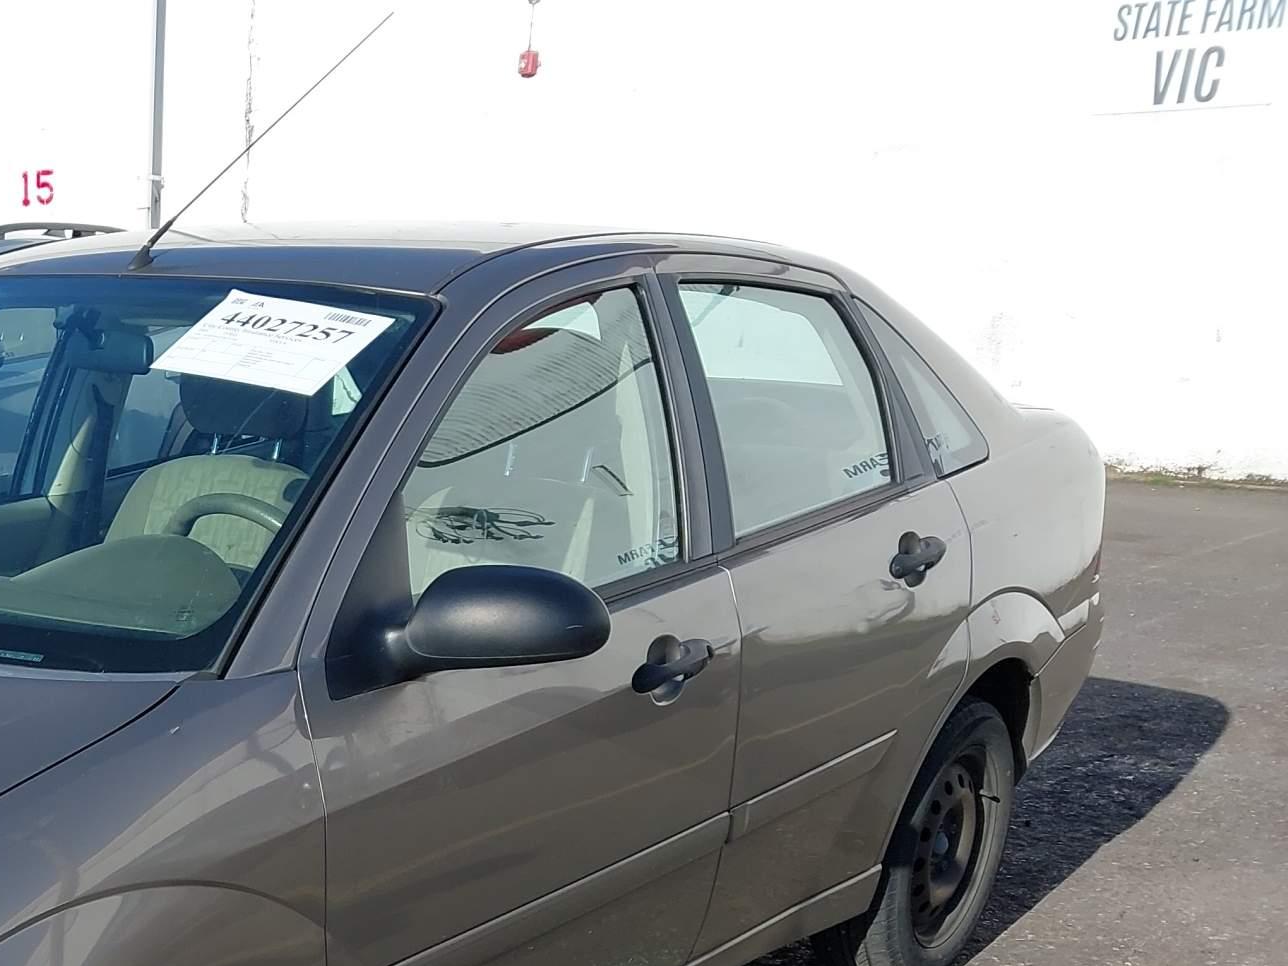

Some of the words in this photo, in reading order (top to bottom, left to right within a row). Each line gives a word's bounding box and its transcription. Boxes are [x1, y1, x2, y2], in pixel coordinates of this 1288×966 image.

[1113, 0, 1195, 42] STATE
[1200, 0, 1287, 34] FARM
[1152, 45, 1226, 106] VIC
[21, 169, 55, 208] 15
[220, 311, 355, 344] 44027257
